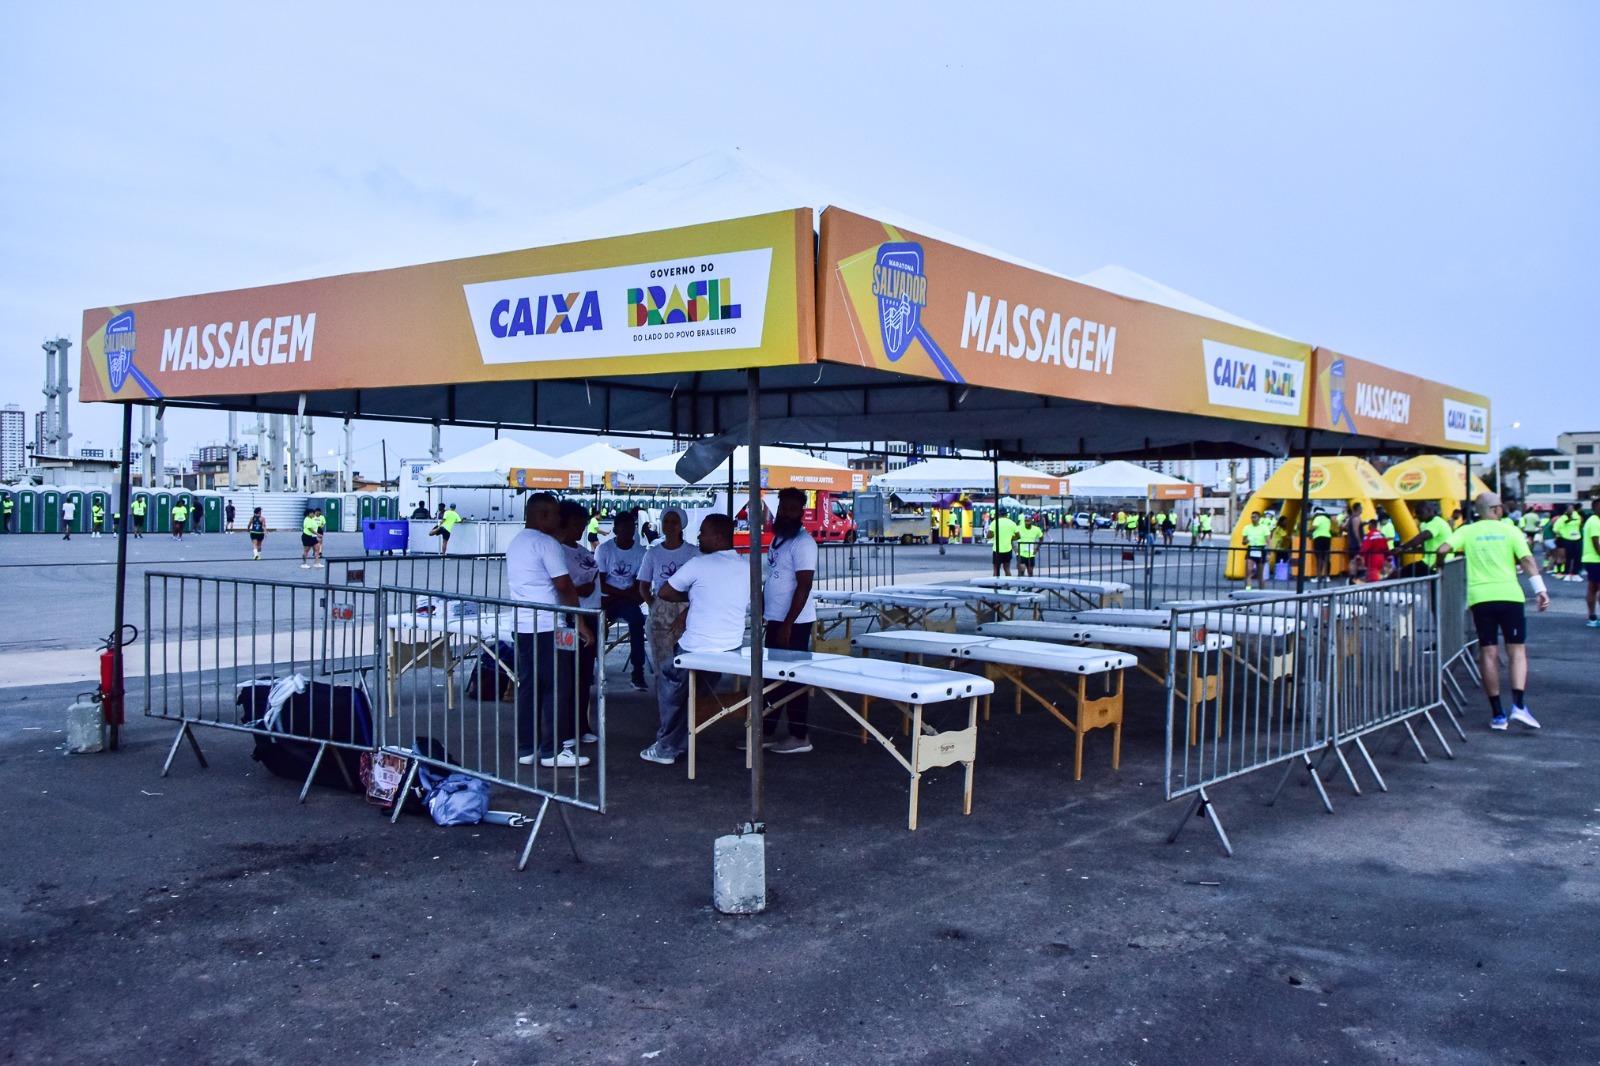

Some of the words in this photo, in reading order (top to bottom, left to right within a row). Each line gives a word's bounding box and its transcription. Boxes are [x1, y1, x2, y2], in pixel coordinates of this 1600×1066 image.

[649, 265, 695, 278] GOVERNO
[700, 262, 714, 273] DO
[873, 264, 926, 306] SALVADOR
[888, 259, 914, 271] MARATONA
[490, 290, 604, 339] CAIXA
[627, 277, 742, 328] BRASIL
[159, 312, 317, 373] MASSAGEM
[633, 334, 643, 342] DO
[645, 332, 663, 341] LADO
[664, 331, 675, 339] DO
[676, 329, 695, 338] POVO
[696, 327, 737, 337] BRASILEIRO
[960, 291, 1117, 375] MASSAGEM
[1213, 356, 1257, 392] CAIXA
[1264, 368, 1296, 398] BRASIL
[1354, 382, 1411, 425] MASSAGEM
